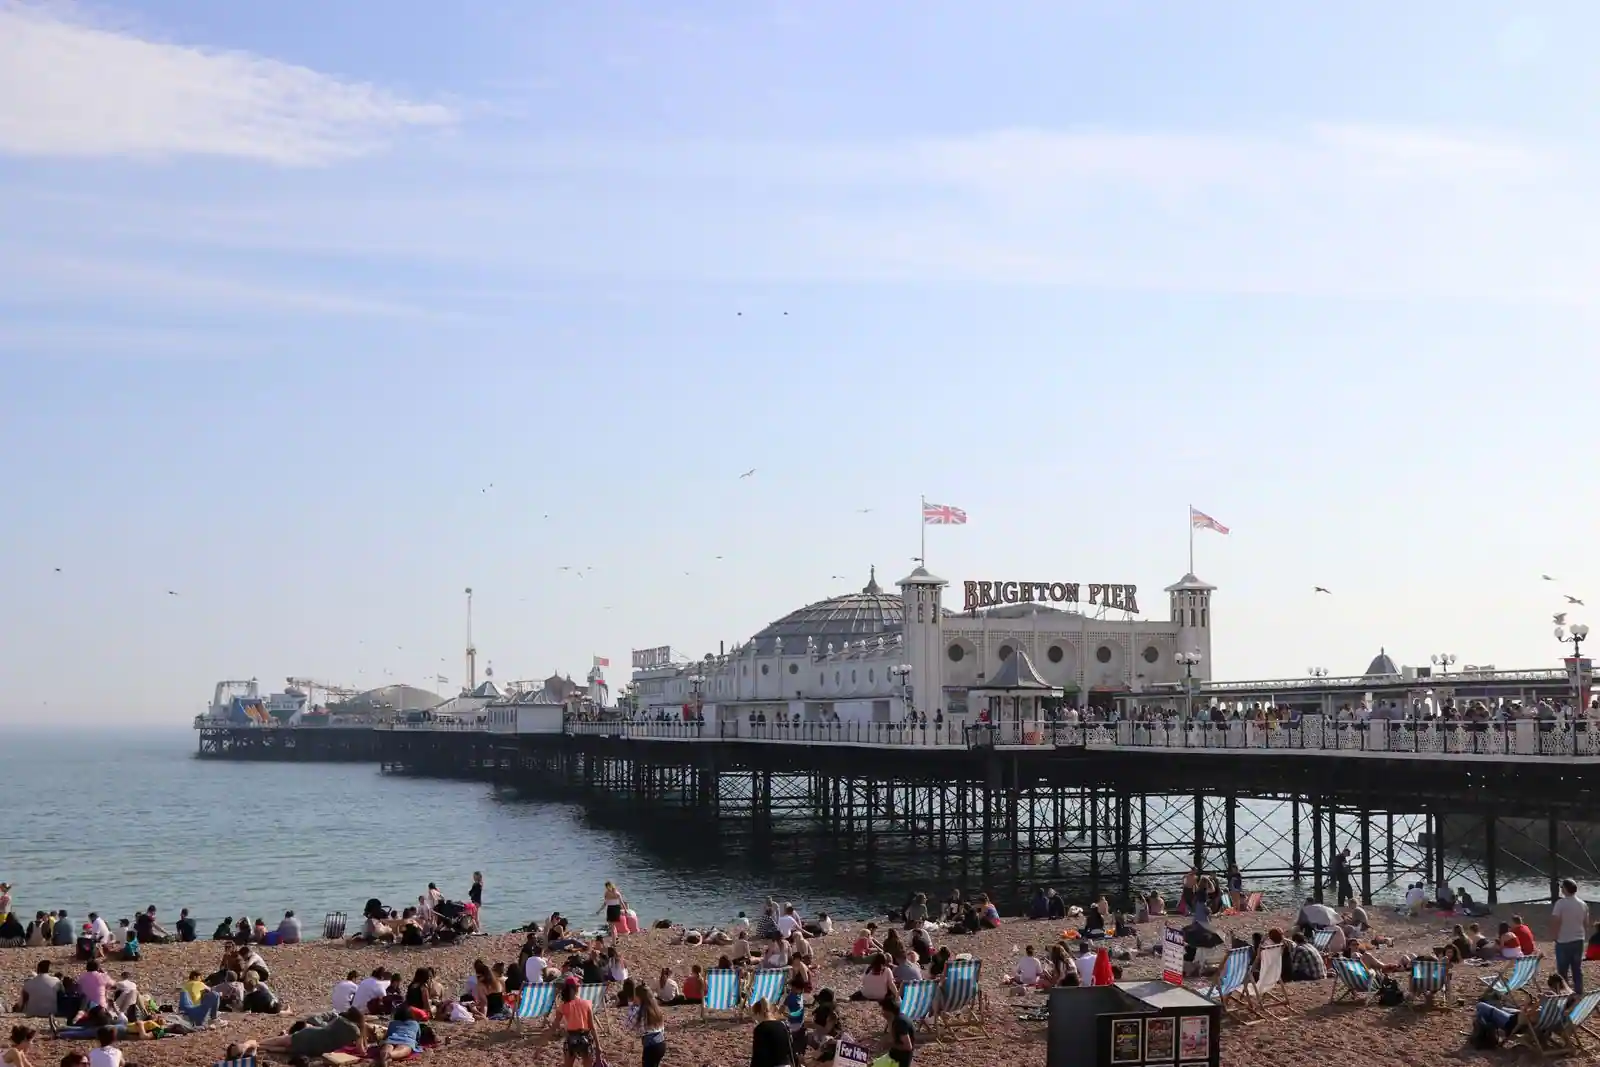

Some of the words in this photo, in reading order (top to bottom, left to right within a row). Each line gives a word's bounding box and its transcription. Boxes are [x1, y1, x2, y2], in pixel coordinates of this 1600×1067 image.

[964, 581, 1079, 611] BRIGHTON
[1089, 584, 1139, 613] PIER
[841, 1043, 852, 1058] For
[853, 1046, 867, 1061] Hire
